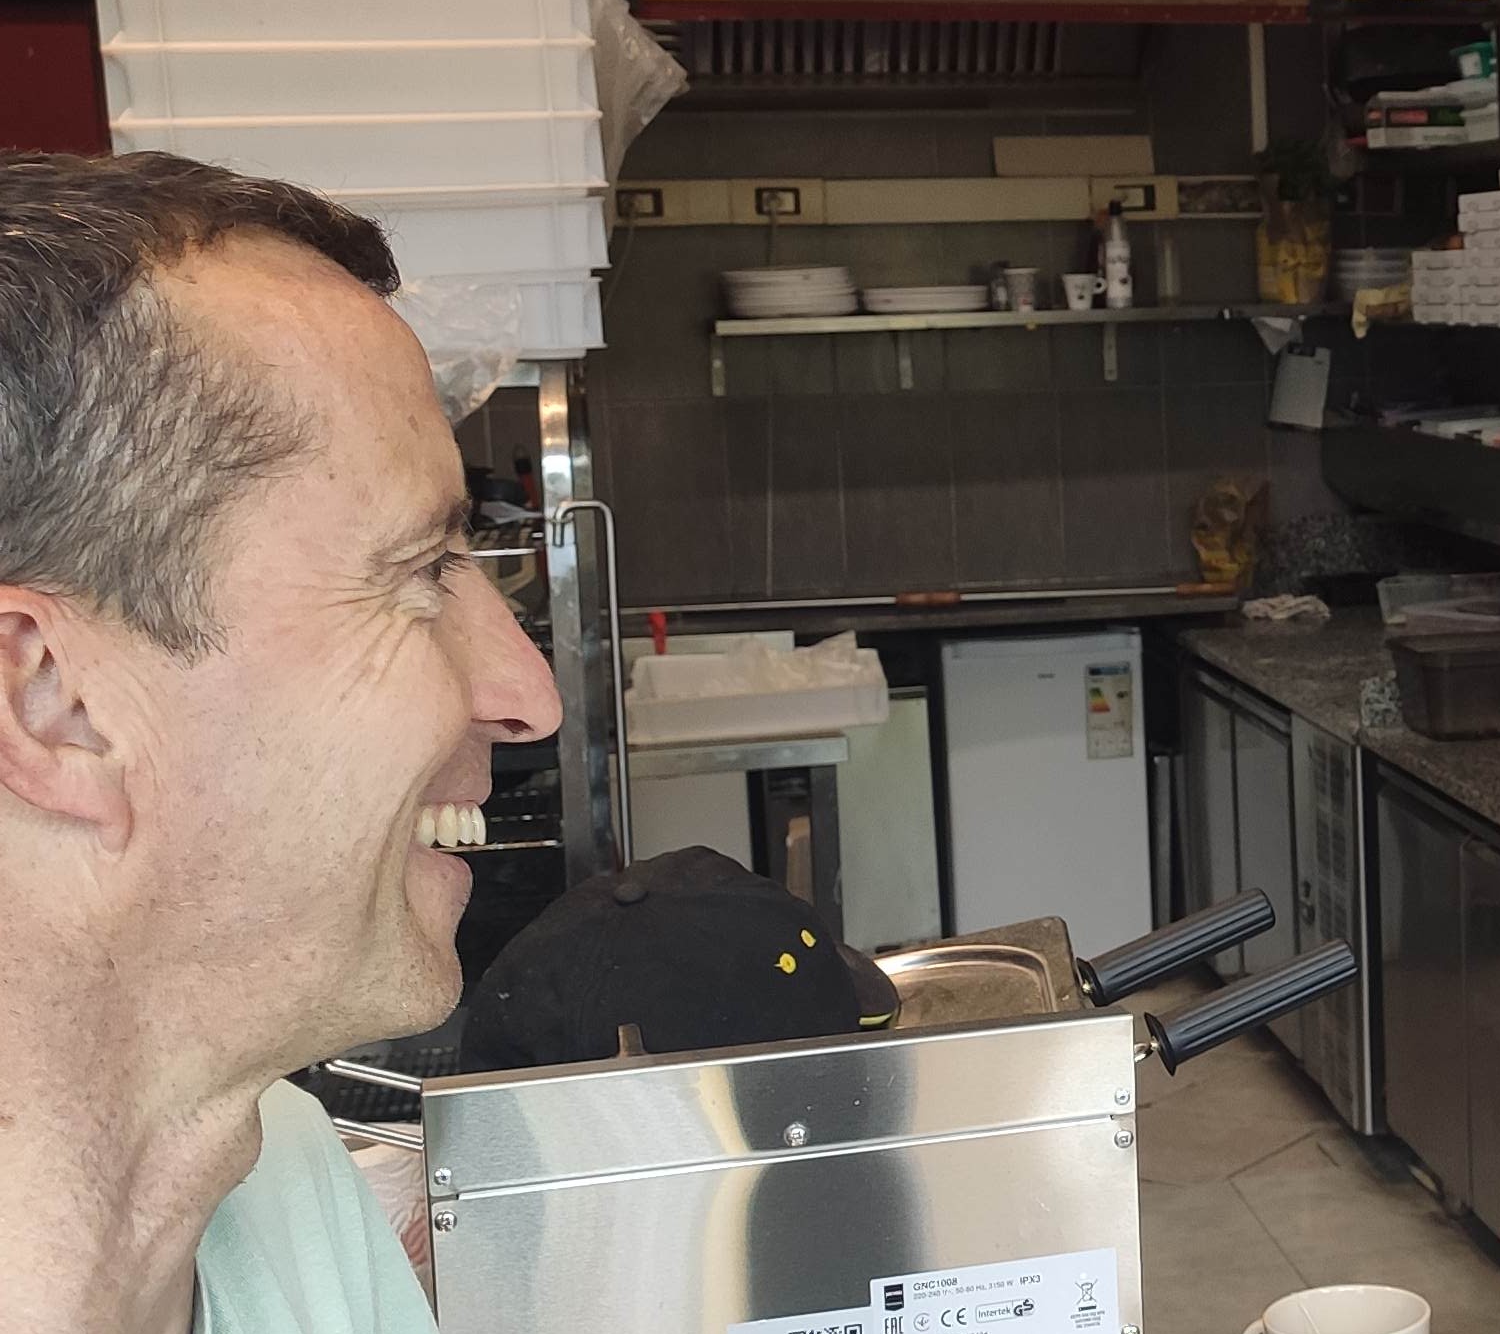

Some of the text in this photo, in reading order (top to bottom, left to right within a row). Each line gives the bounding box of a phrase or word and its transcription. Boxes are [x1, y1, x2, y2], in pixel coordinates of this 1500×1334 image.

[913, 1277, 958, 1291] GNC1008
[1020, 1274, 1041, 1285] IPX3
[978, 1307, 1011, 1319] Intertek
[1013, 1299, 1034, 1316] GS
[940, 1307, 967, 1328] CE
